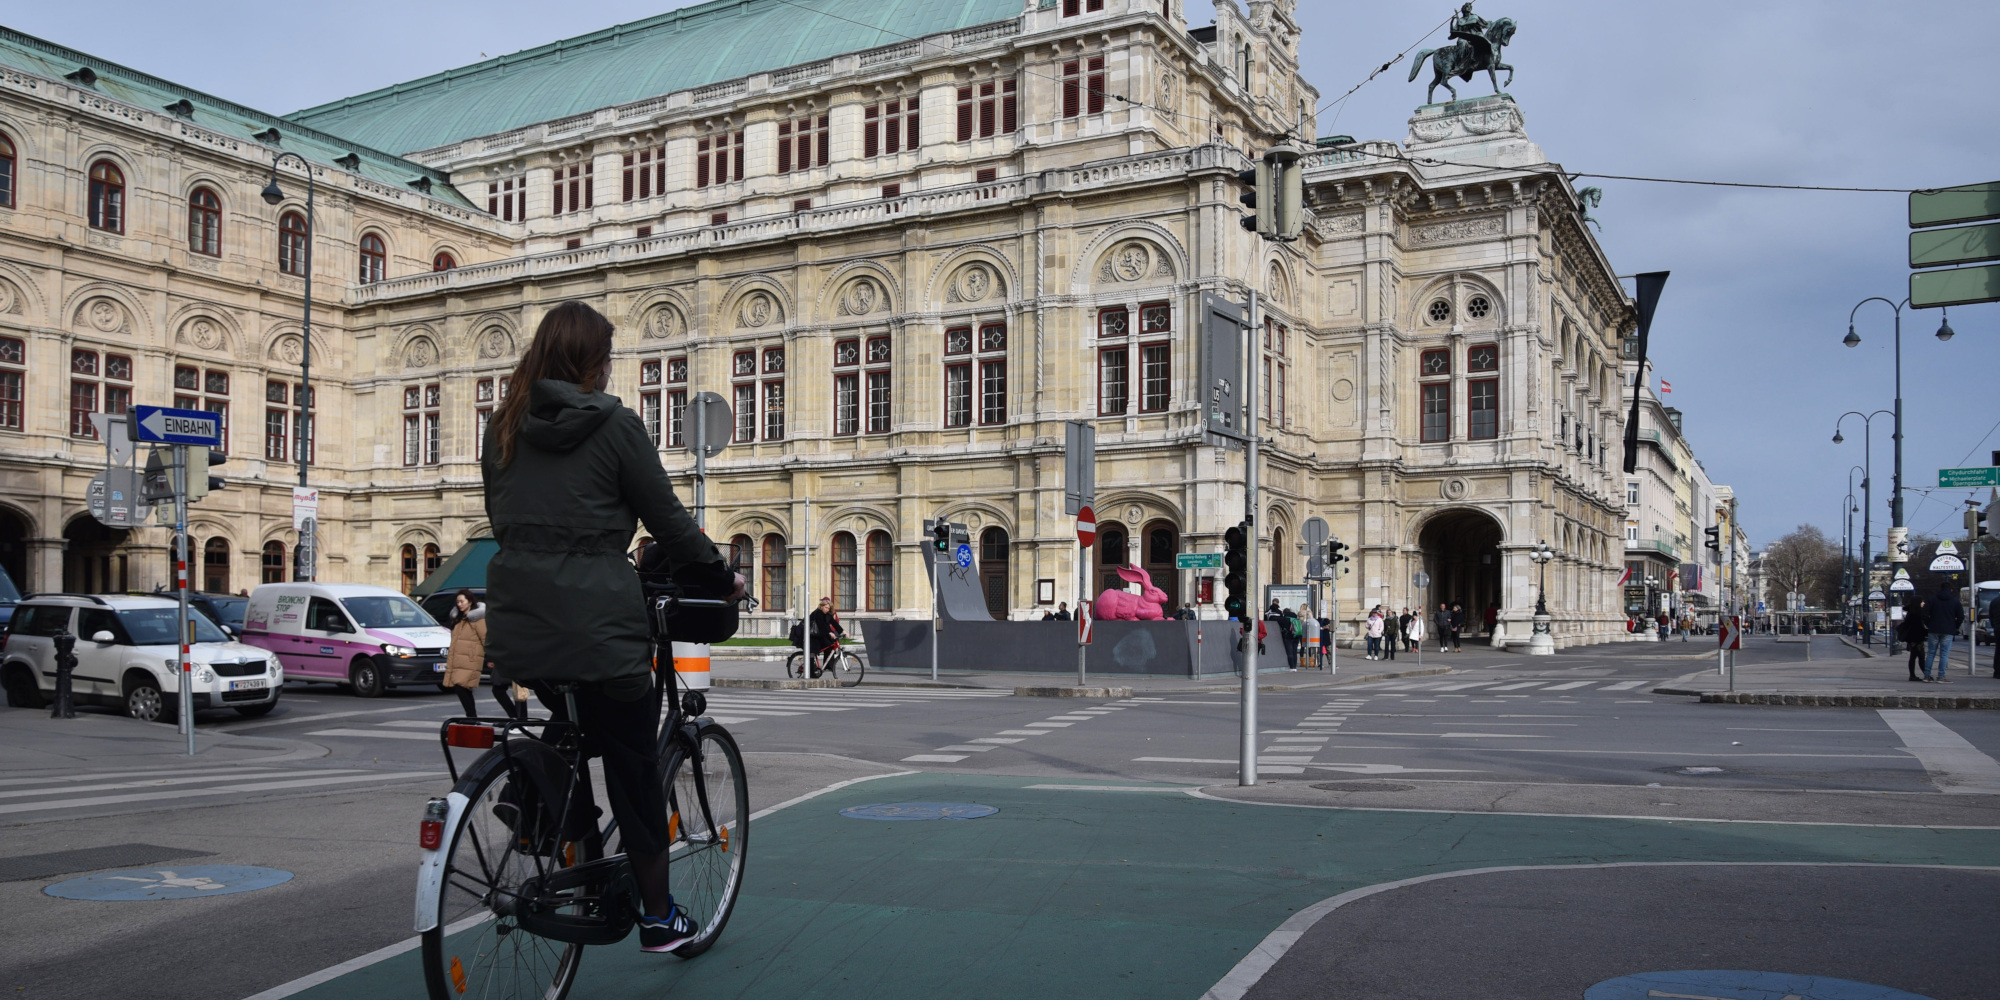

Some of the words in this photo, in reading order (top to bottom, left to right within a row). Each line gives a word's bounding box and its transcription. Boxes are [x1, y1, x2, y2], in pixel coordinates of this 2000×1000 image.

[165, 418, 211, 435] EINBAHN
[277, 595, 306, 604] BRONCHO
[275, 604, 290, 612] STOP
